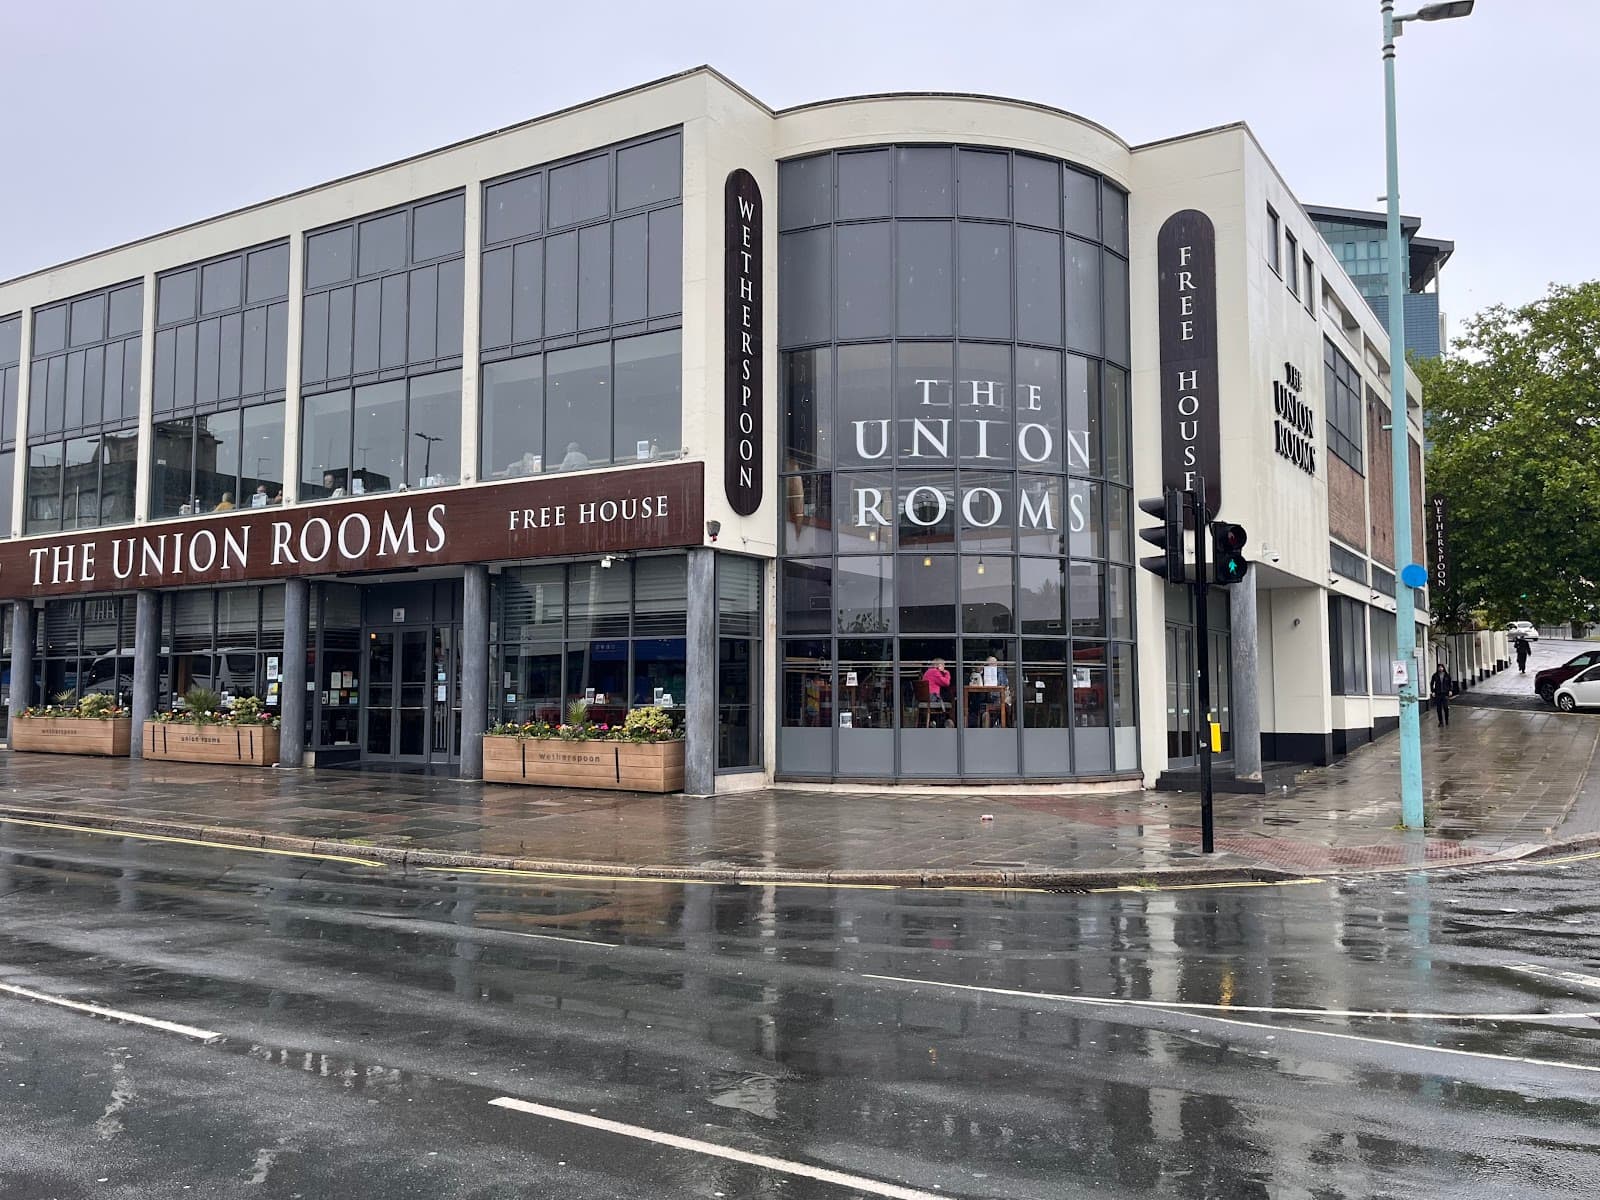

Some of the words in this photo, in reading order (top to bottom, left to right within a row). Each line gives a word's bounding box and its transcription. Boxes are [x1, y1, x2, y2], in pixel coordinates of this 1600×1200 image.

[1178, 246, 1197, 341] FREE
[738, 196, 755, 489] WETHERSPOON
[915, 379, 1042, 411] THE
[1177, 369, 1199, 491] HOUSE
[1273, 380, 1313, 438] UNION
[852, 418, 1090, 469] UNION
[508, 505, 566, 531] FREE
[578, 495, 669, 524] HOUSE
[854, 486, 1085, 532] ROOMS
[1433, 499, 1446, 586] WETHERSPOON
[29, 542, 96, 586] THE
[112, 524, 251, 579] UNION
[270, 503, 446, 566] ROOMS
